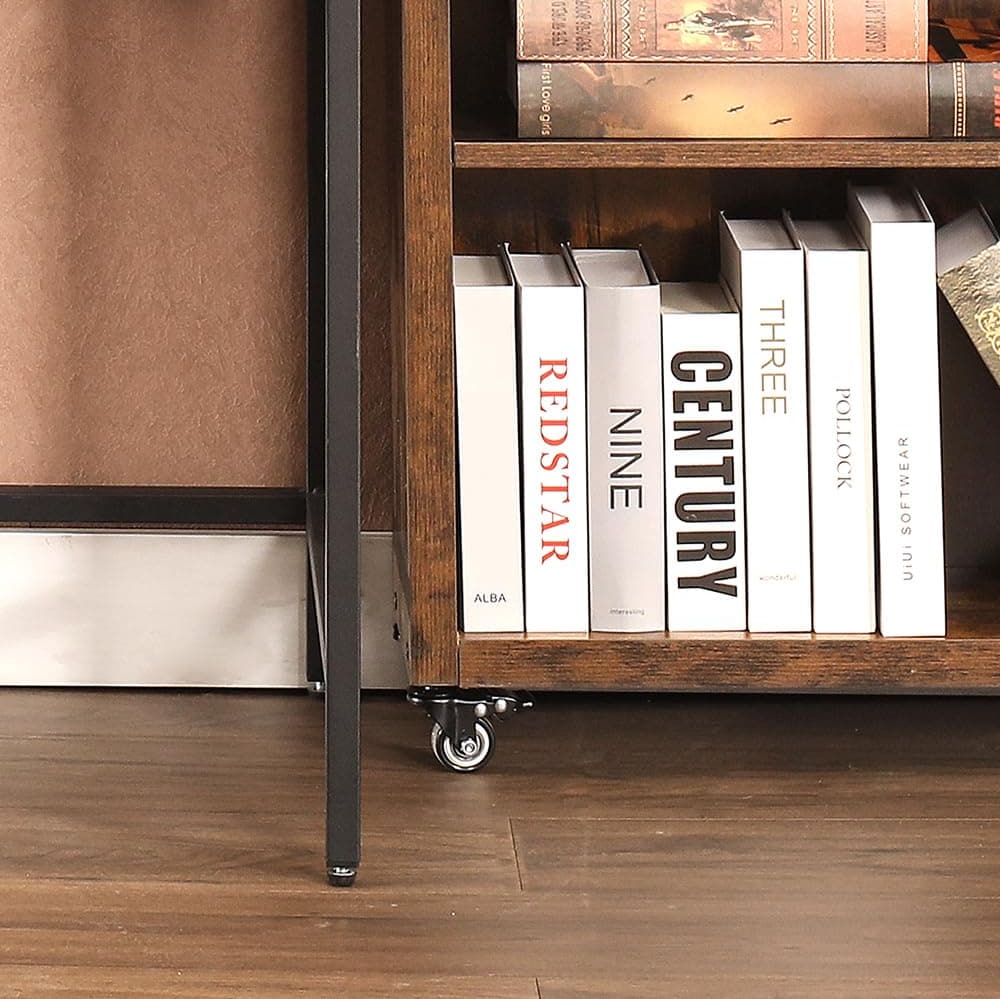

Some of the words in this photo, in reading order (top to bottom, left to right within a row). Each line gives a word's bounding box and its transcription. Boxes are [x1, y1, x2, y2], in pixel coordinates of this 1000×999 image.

[541, 63, 553, 84] First
[541, 86, 553, 112] Love
[760, 299, 787, 415] THREE
[539, 358, 570, 565] REDSTAR
[609, 407, 643, 510] NINE
[670, 350, 738, 598] CENTURY
[836, 389, 851, 488] POLLOCK
[898, 438, 911, 535] SOFTWEAR
[474, 593, 506, 603] ALBA
